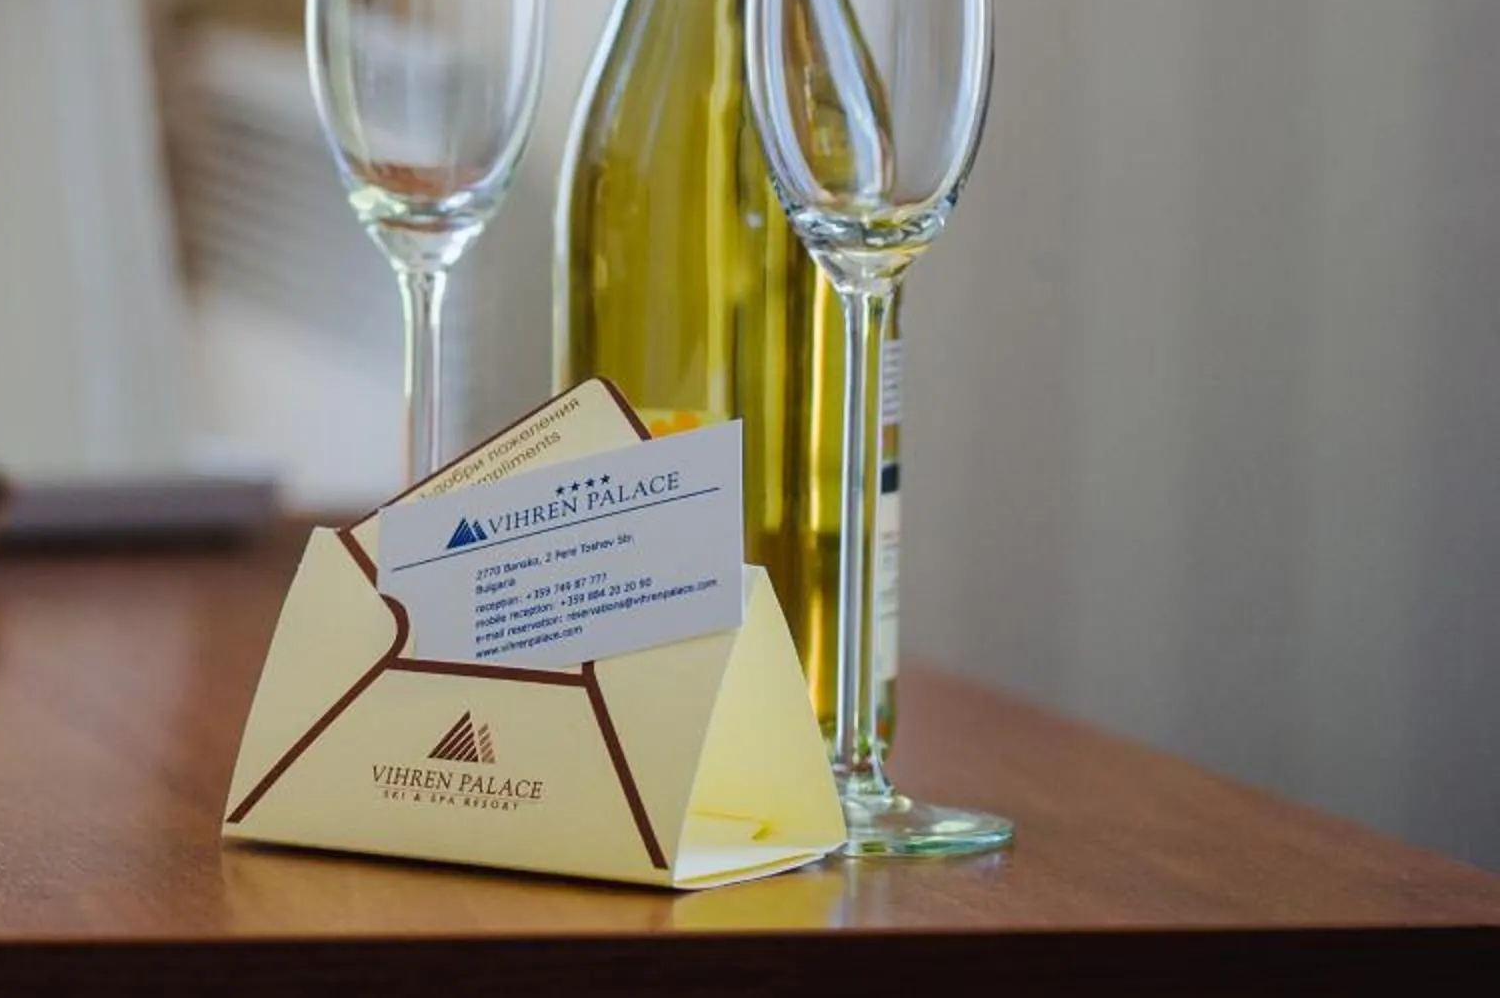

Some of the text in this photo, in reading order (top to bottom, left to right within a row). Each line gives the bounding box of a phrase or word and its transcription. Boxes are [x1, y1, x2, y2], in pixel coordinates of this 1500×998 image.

[487, 470, 681, 535] VIHREN PALACE
[372, 765, 544, 799] VIHREN PALACE
[384, 789, 406, 801] SKI
[431, 794, 456, 805] SPA
[464, 797, 519, 811] RESORT
